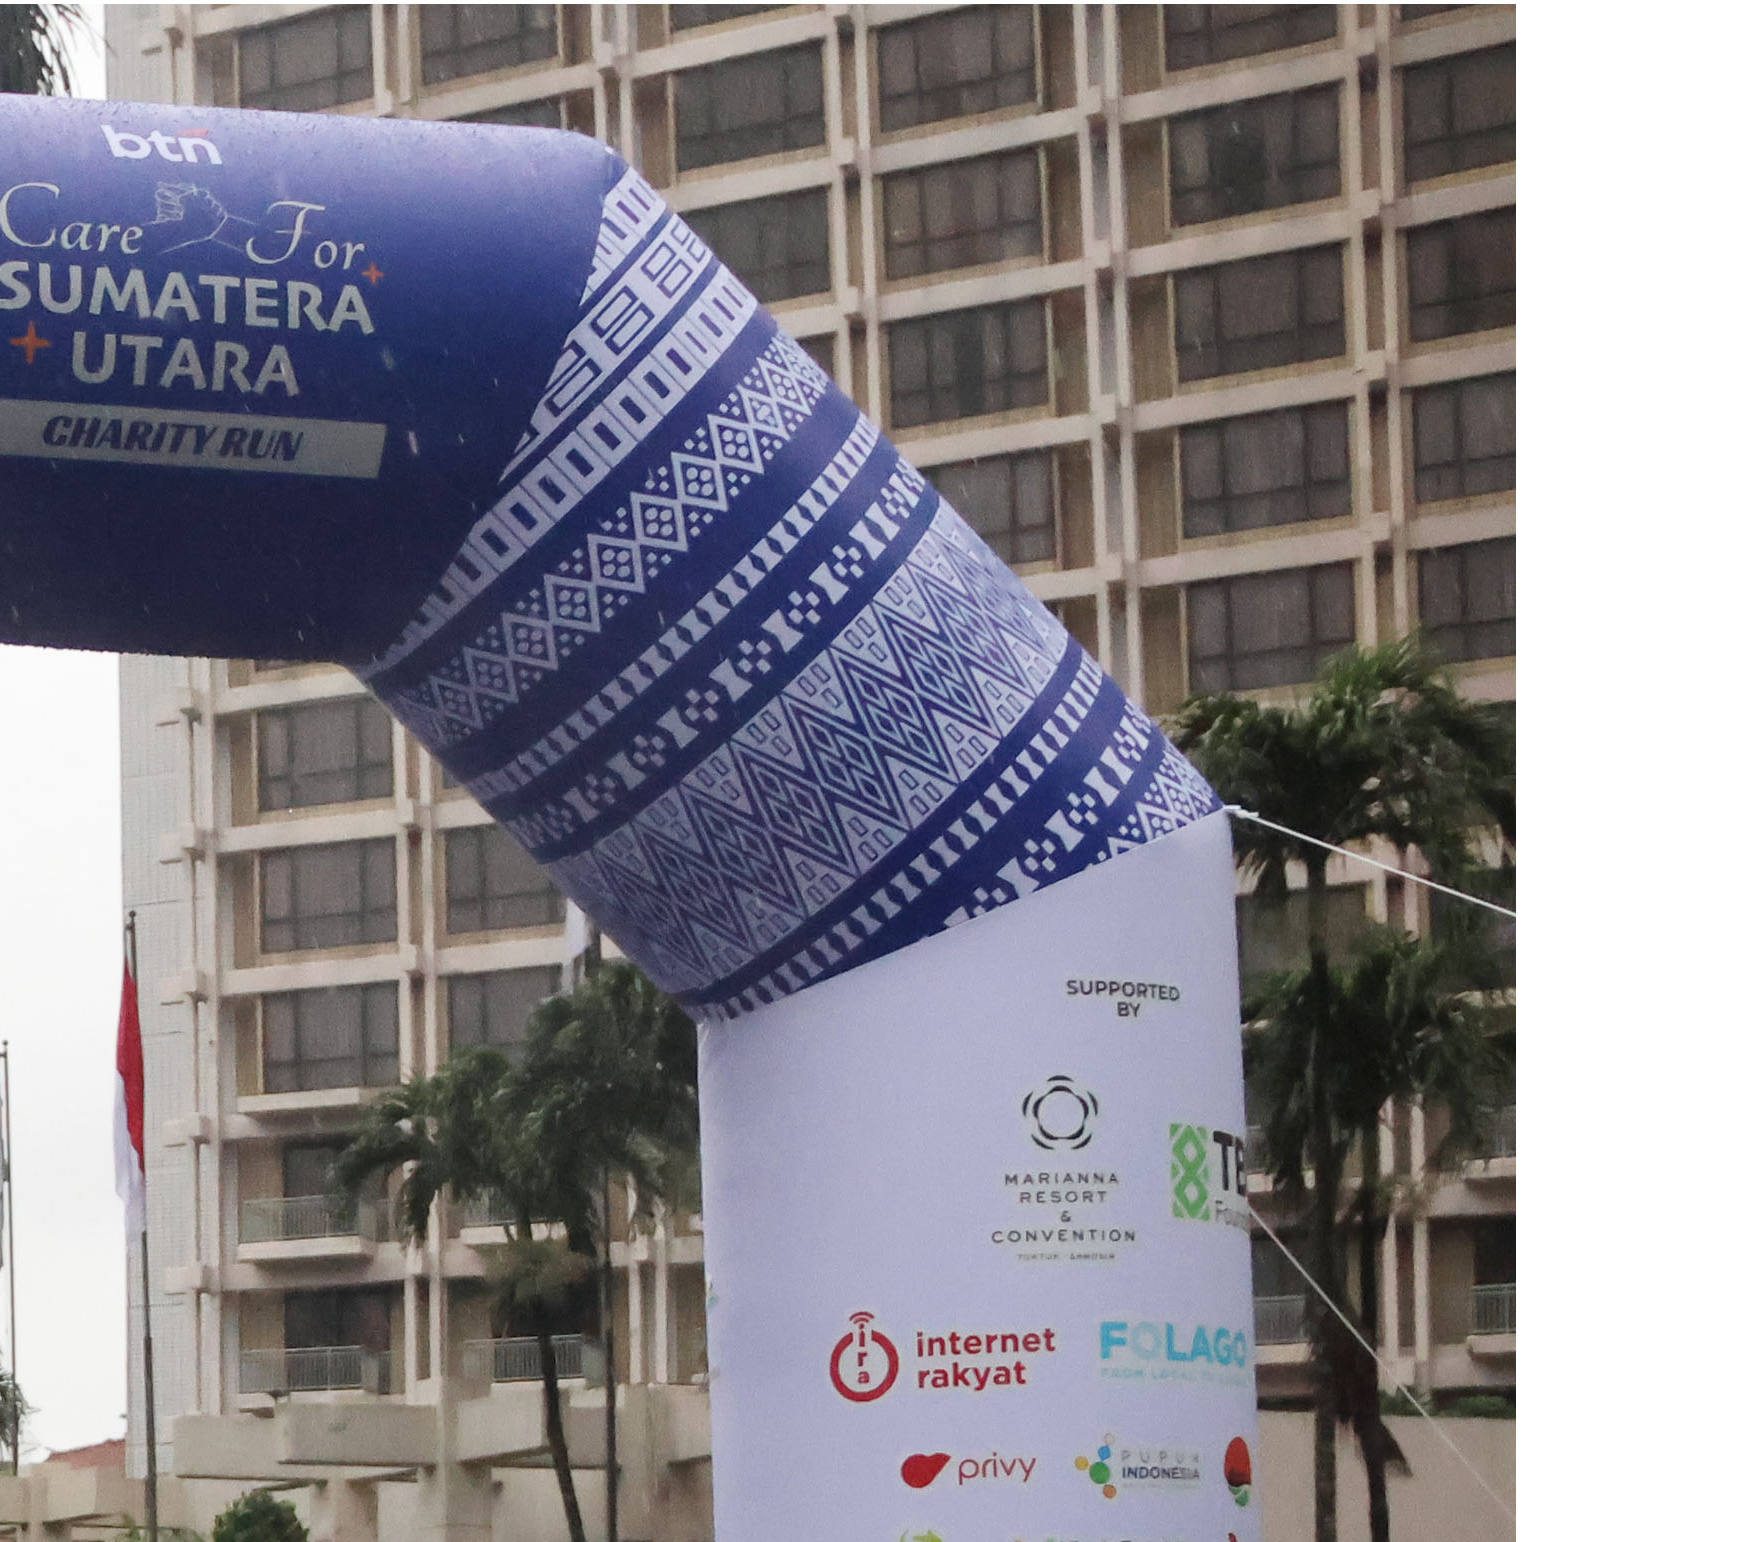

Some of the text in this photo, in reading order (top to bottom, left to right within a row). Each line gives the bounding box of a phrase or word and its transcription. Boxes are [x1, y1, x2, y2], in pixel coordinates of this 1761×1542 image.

[101, 125, 222, 164] btn
[245, 200, 366, 270] For
[72, 331, 300, 396] UTARA
[43, 414, 305, 462] CHARITY RUN
[1066, 979, 1179, 1002] SUPPORTED
[1117, 1002, 1140, 1018] BY
[1005, 1173, 1119, 1186] MARIANNA
[1019, 1191, 1108, 1203] RESORT
[1061, 1211, 1072, 1222] &
[991, 1229, 1136, 1243] CONVENTION
[917, 1328, 1055, 1357] internet
[1100, 1321, 1247, 1368] FOLAGO
[918, 1361, 1026, 1391] rakyat
[958, 1451, 1037, 1485] privy
[1122, 1467, 1199, 1479] INDONESIA
